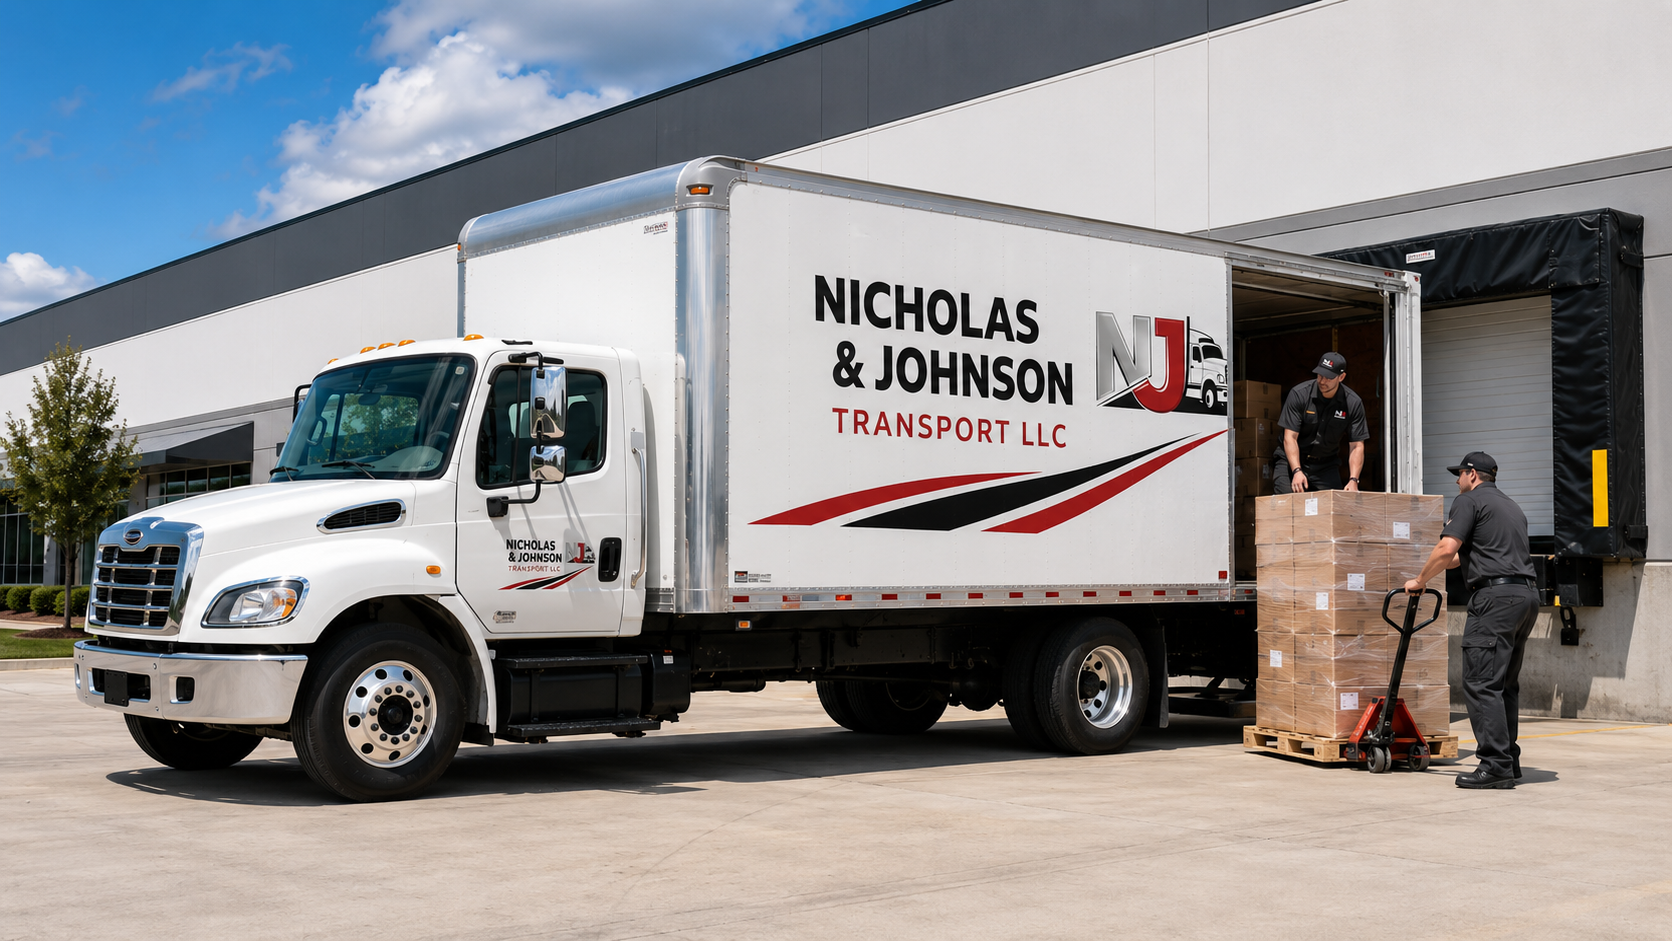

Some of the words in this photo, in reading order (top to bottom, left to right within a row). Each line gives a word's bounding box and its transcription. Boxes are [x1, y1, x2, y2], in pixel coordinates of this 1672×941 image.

[814, 274, 1040, 345] NICHOLAS
[832, 340, 866, 389] &
[874, 344, 1074, 406] JOHNSON
[1095, 311, 1186, 413] NJ
[832, 407, 1010, 444] TRANSPORT
[1022, 421, 1067, 449] LLC
[506, 539, 556, 551] NICHOLAS
[508, 551, 516, 563] &
[517, 552, 563, 563] JOHNSON
[565, 542, 585, 563] NJ
